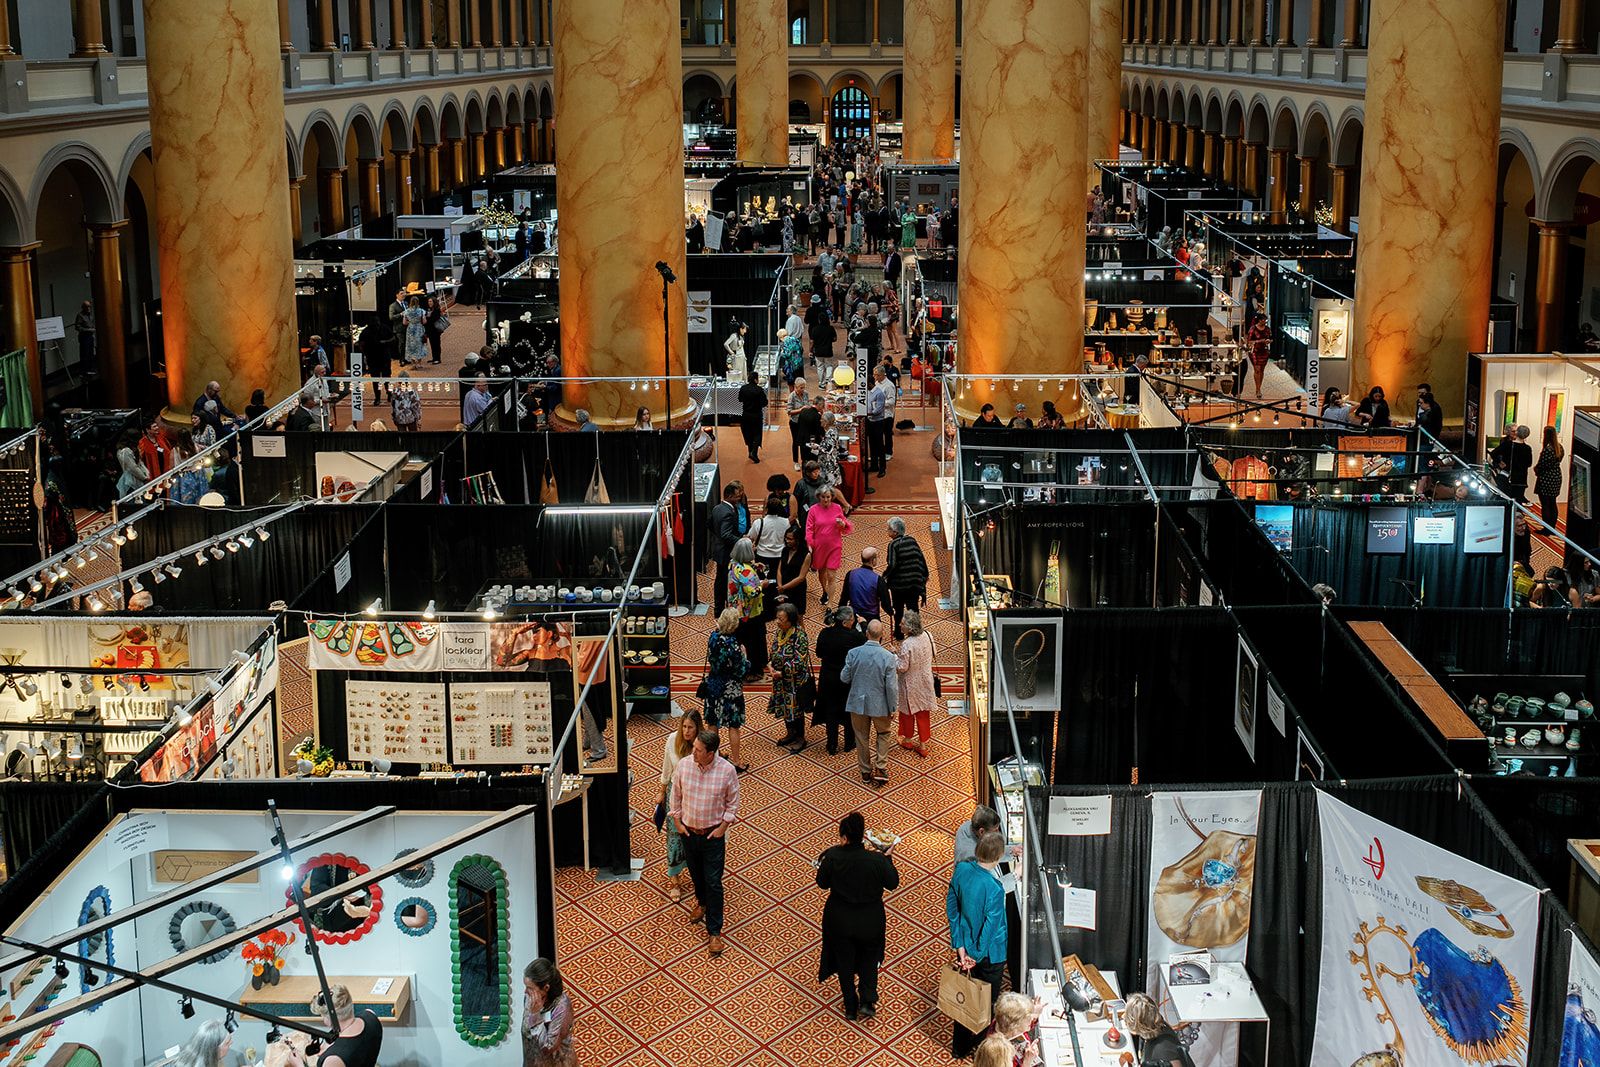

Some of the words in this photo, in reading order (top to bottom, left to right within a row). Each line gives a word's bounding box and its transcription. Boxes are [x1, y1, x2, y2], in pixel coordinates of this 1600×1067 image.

[858, 359, 867, 378] 200
[1309, 360, 1318, 378] 100
[858, 381, 867, 405] Aisle
[1309, 383, 1318, 408] Aisle
[454, 635, 474, 644] tara
[445, 646, 484, 655] locklear
